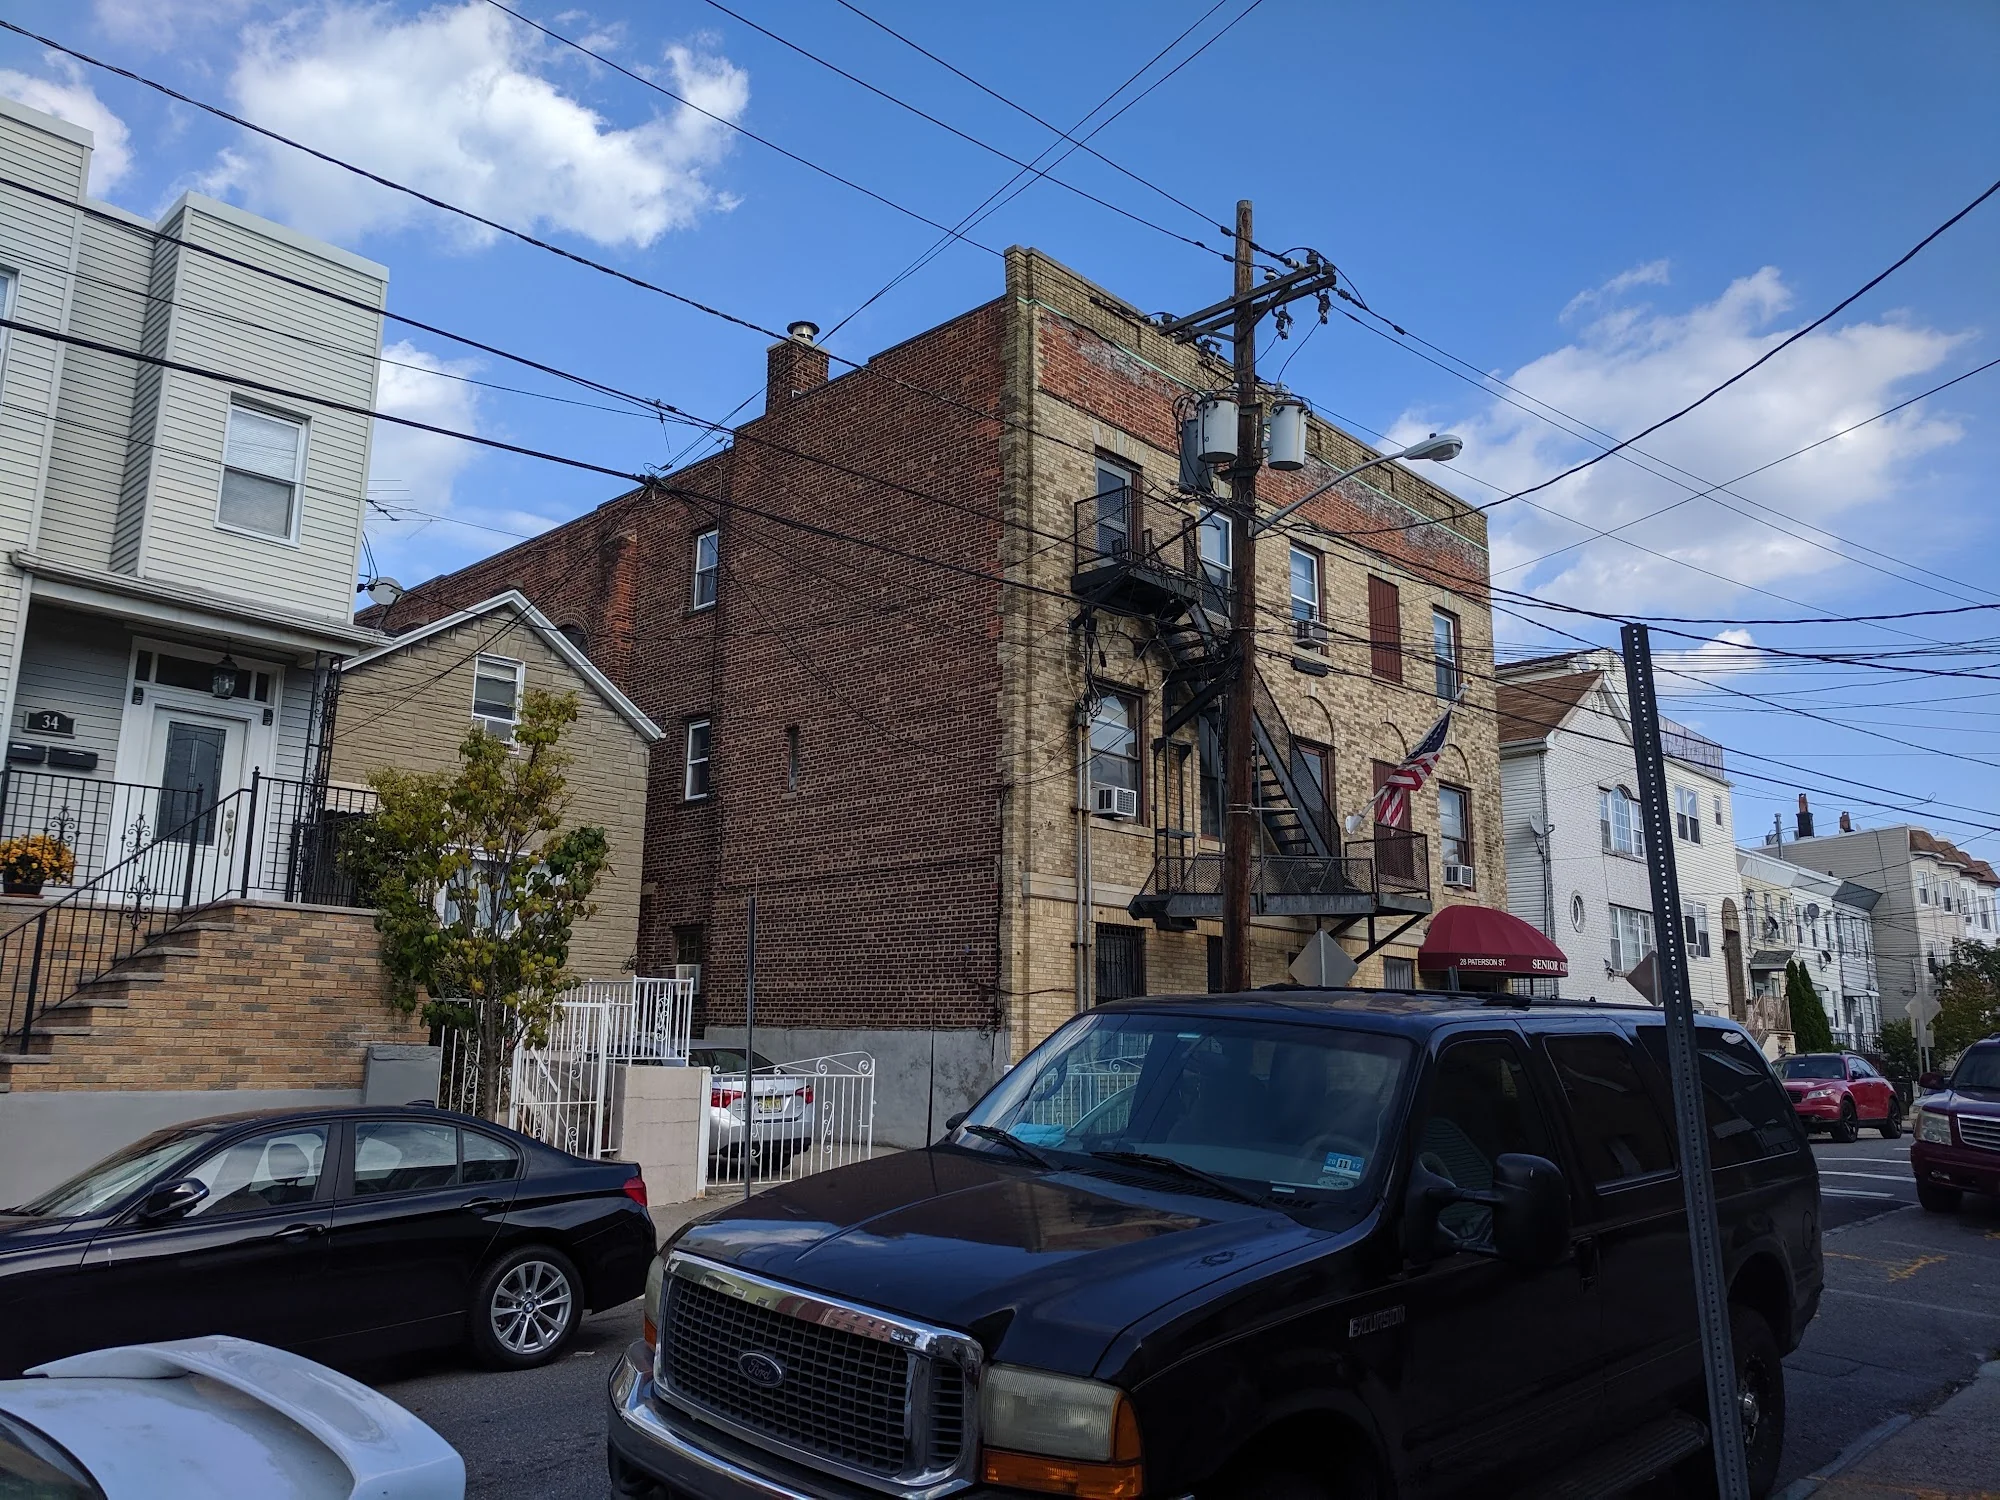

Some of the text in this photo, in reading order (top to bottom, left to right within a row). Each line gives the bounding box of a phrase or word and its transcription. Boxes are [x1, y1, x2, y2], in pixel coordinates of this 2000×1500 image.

[41, 714, 60, 730] 34
[1459, 958, 1507, 967] 28 PATERSON ST.
[1532, 959, 1559, 972] SENIOR
[1338, 1159, 1348, 1169] 11
[1348, 1304, 1406, 1338] EXCURSION
[747, 1358, 772, 1381] Ford
